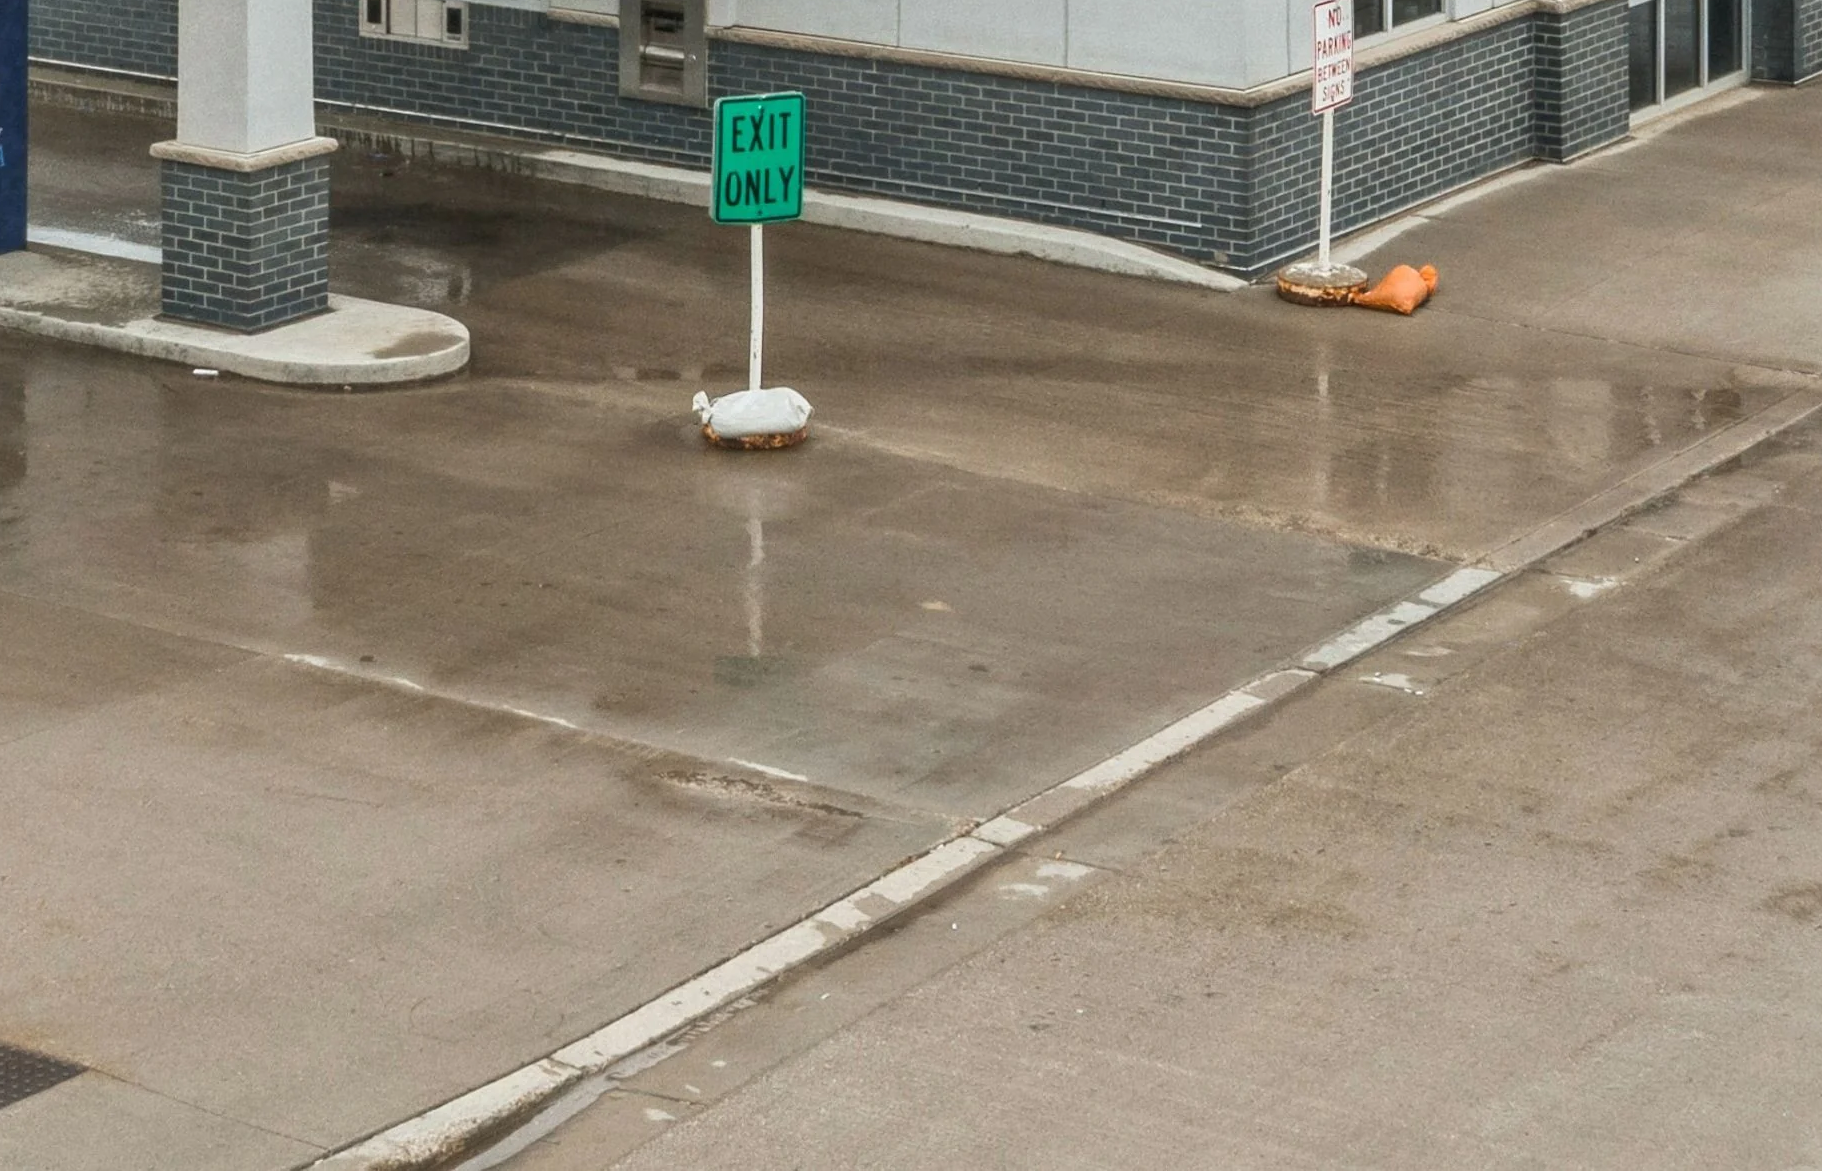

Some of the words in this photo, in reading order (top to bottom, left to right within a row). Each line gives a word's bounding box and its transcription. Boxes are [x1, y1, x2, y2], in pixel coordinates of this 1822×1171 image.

[1328, 6, 1342, 29] NO
[1317, 30, 1352, 60] PARKING
[1317, 58, 1351, 83] BETWEEN
[1322, 79, 1345, 102] SIGNS
[732, 112, 791, 153] EXIT
[725, 165, 795, 207] ONLY
